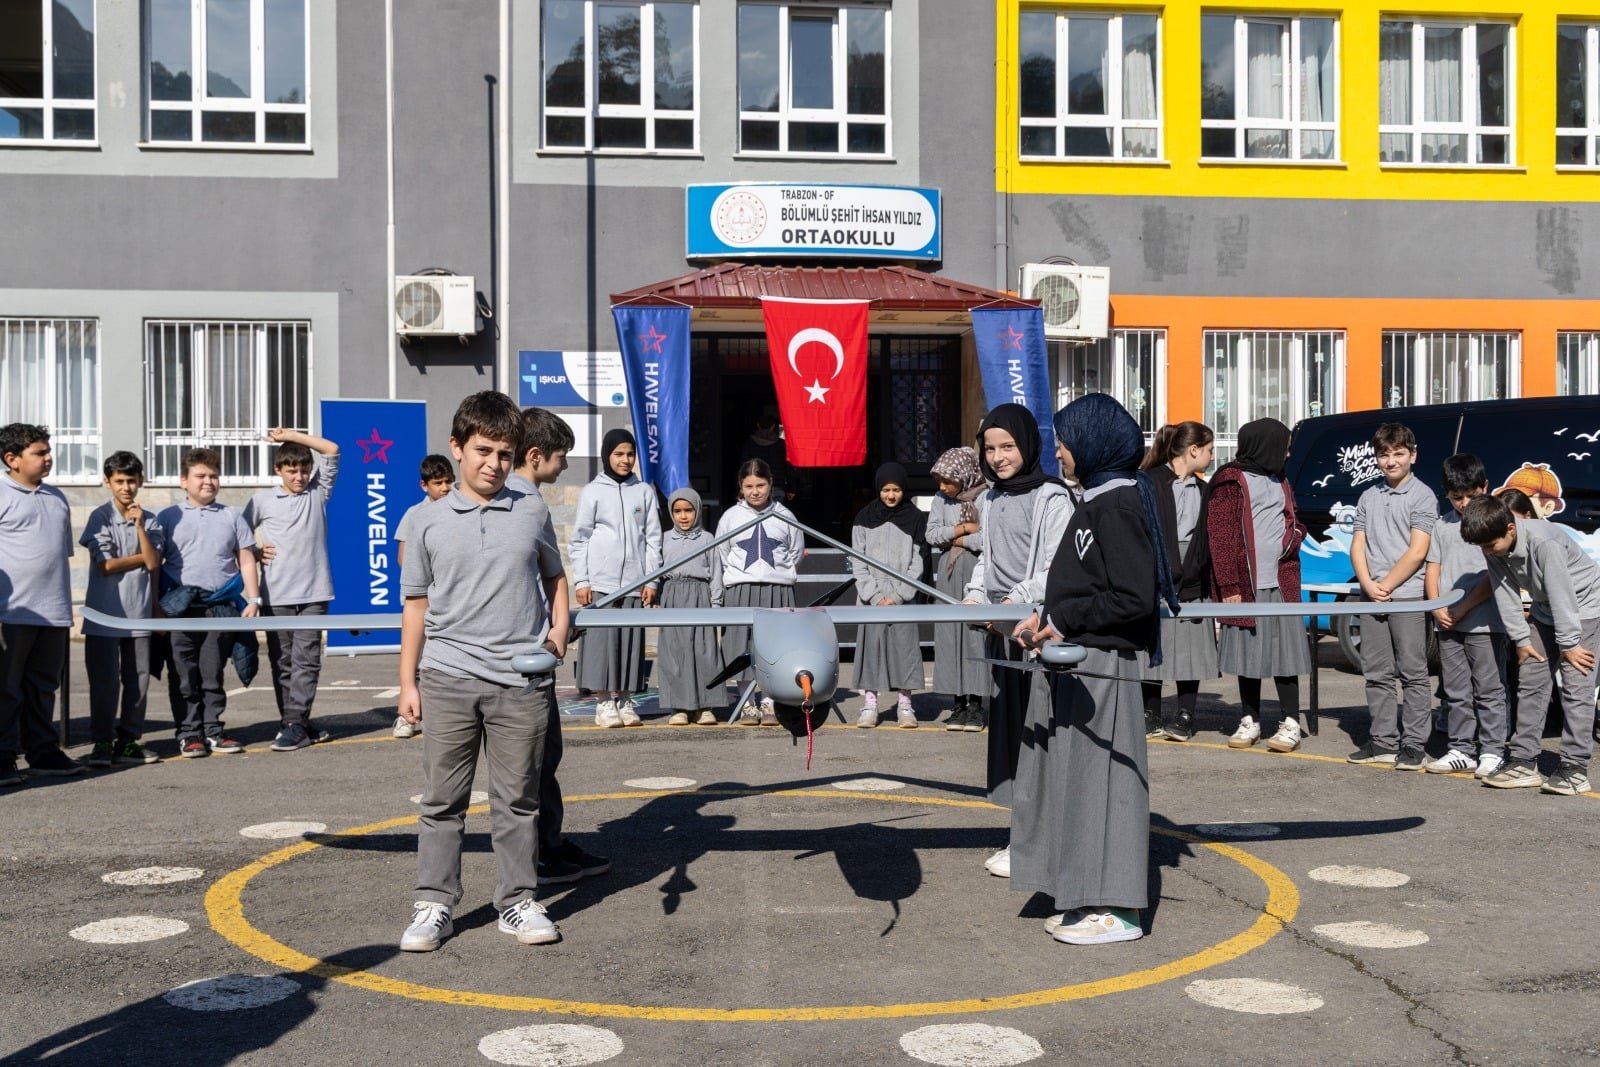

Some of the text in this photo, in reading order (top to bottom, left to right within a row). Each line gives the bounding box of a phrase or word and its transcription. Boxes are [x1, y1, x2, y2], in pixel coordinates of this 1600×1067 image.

[781, 189, 817, 200] TRABZON
[824, 190, 835, 200] OF
[781, 203, 922, 226] BÖLÜMLÜ ŞEHİT İHSAN YILDIZ
[781, 228, 895, 246] ORTAOKULU
[1007, 359, 1027, 406] HAVE
[644, 362, 659, 464] HAVELSAN
[366, 473, 389, 606] HAVELSAN
